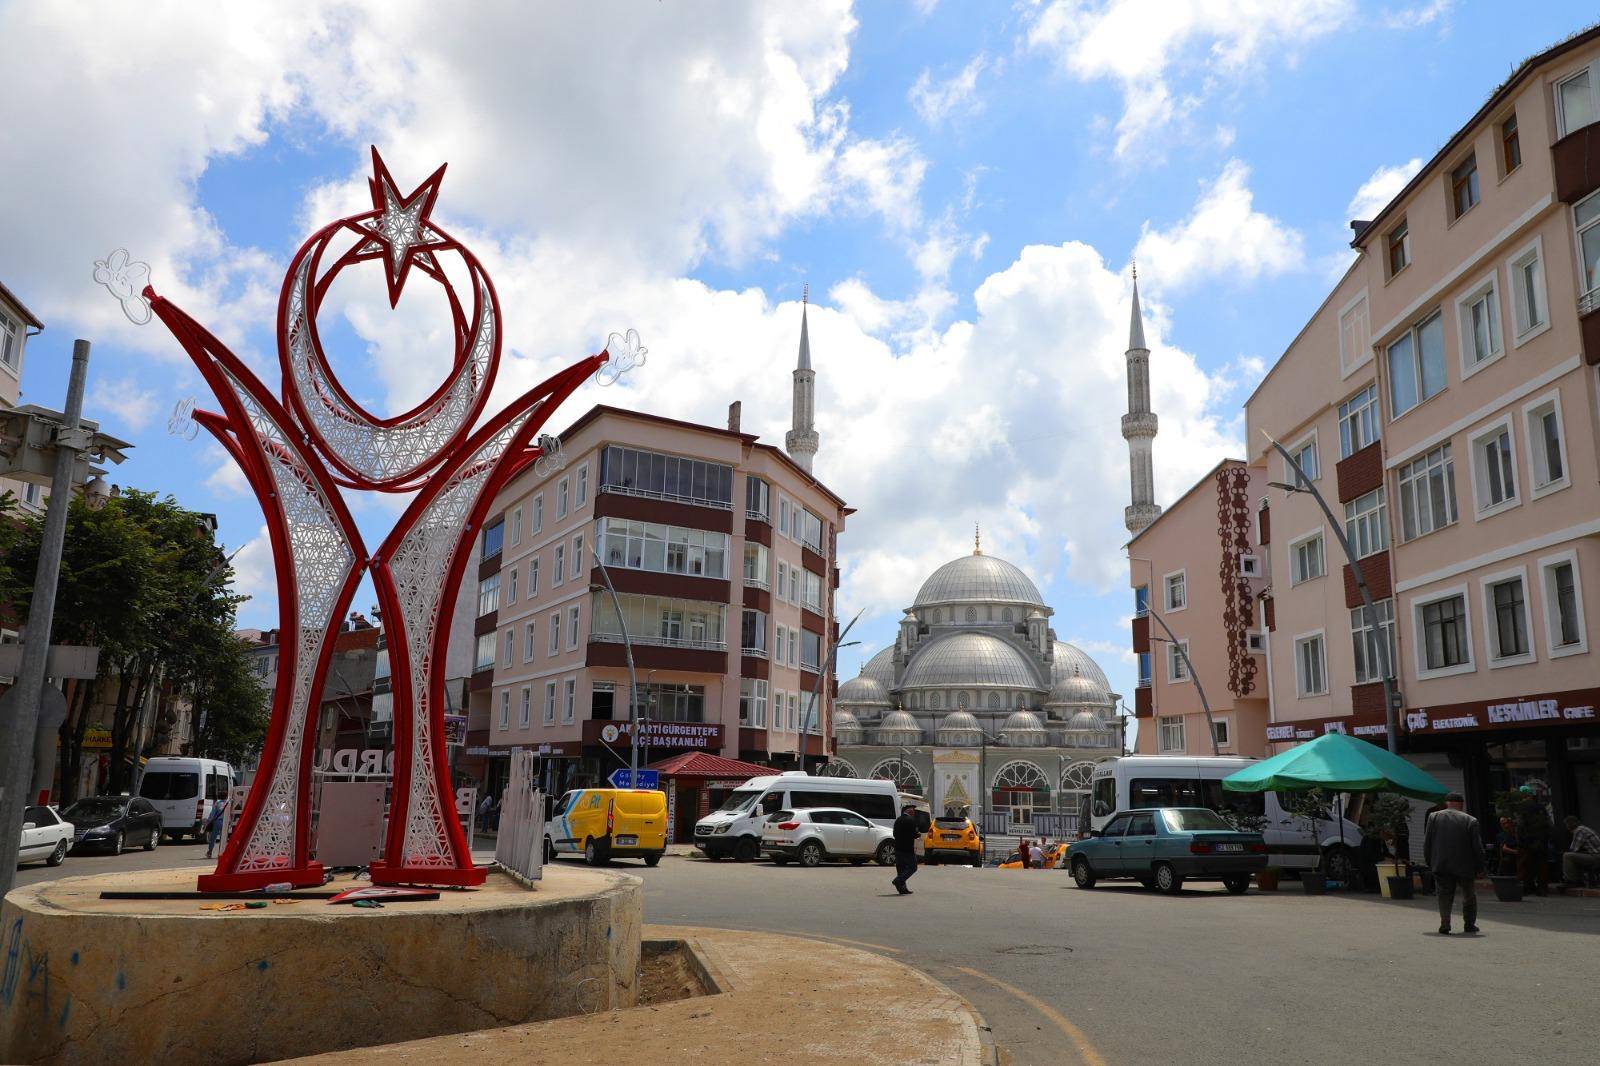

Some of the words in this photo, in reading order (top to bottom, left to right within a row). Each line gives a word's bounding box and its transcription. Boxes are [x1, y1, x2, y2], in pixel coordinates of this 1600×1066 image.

[1487, 698, 1560, 723] KESKİNLER
[1563, 705, 1596, 720] CAFE
[662, 723, 718, 736] GÜRGENTEPE
[631, 735, 651, 748] İÇE
[653, 735, 707, 748] BAŞKANLIĞI
[619, 780, 655, 789] Meudiye
